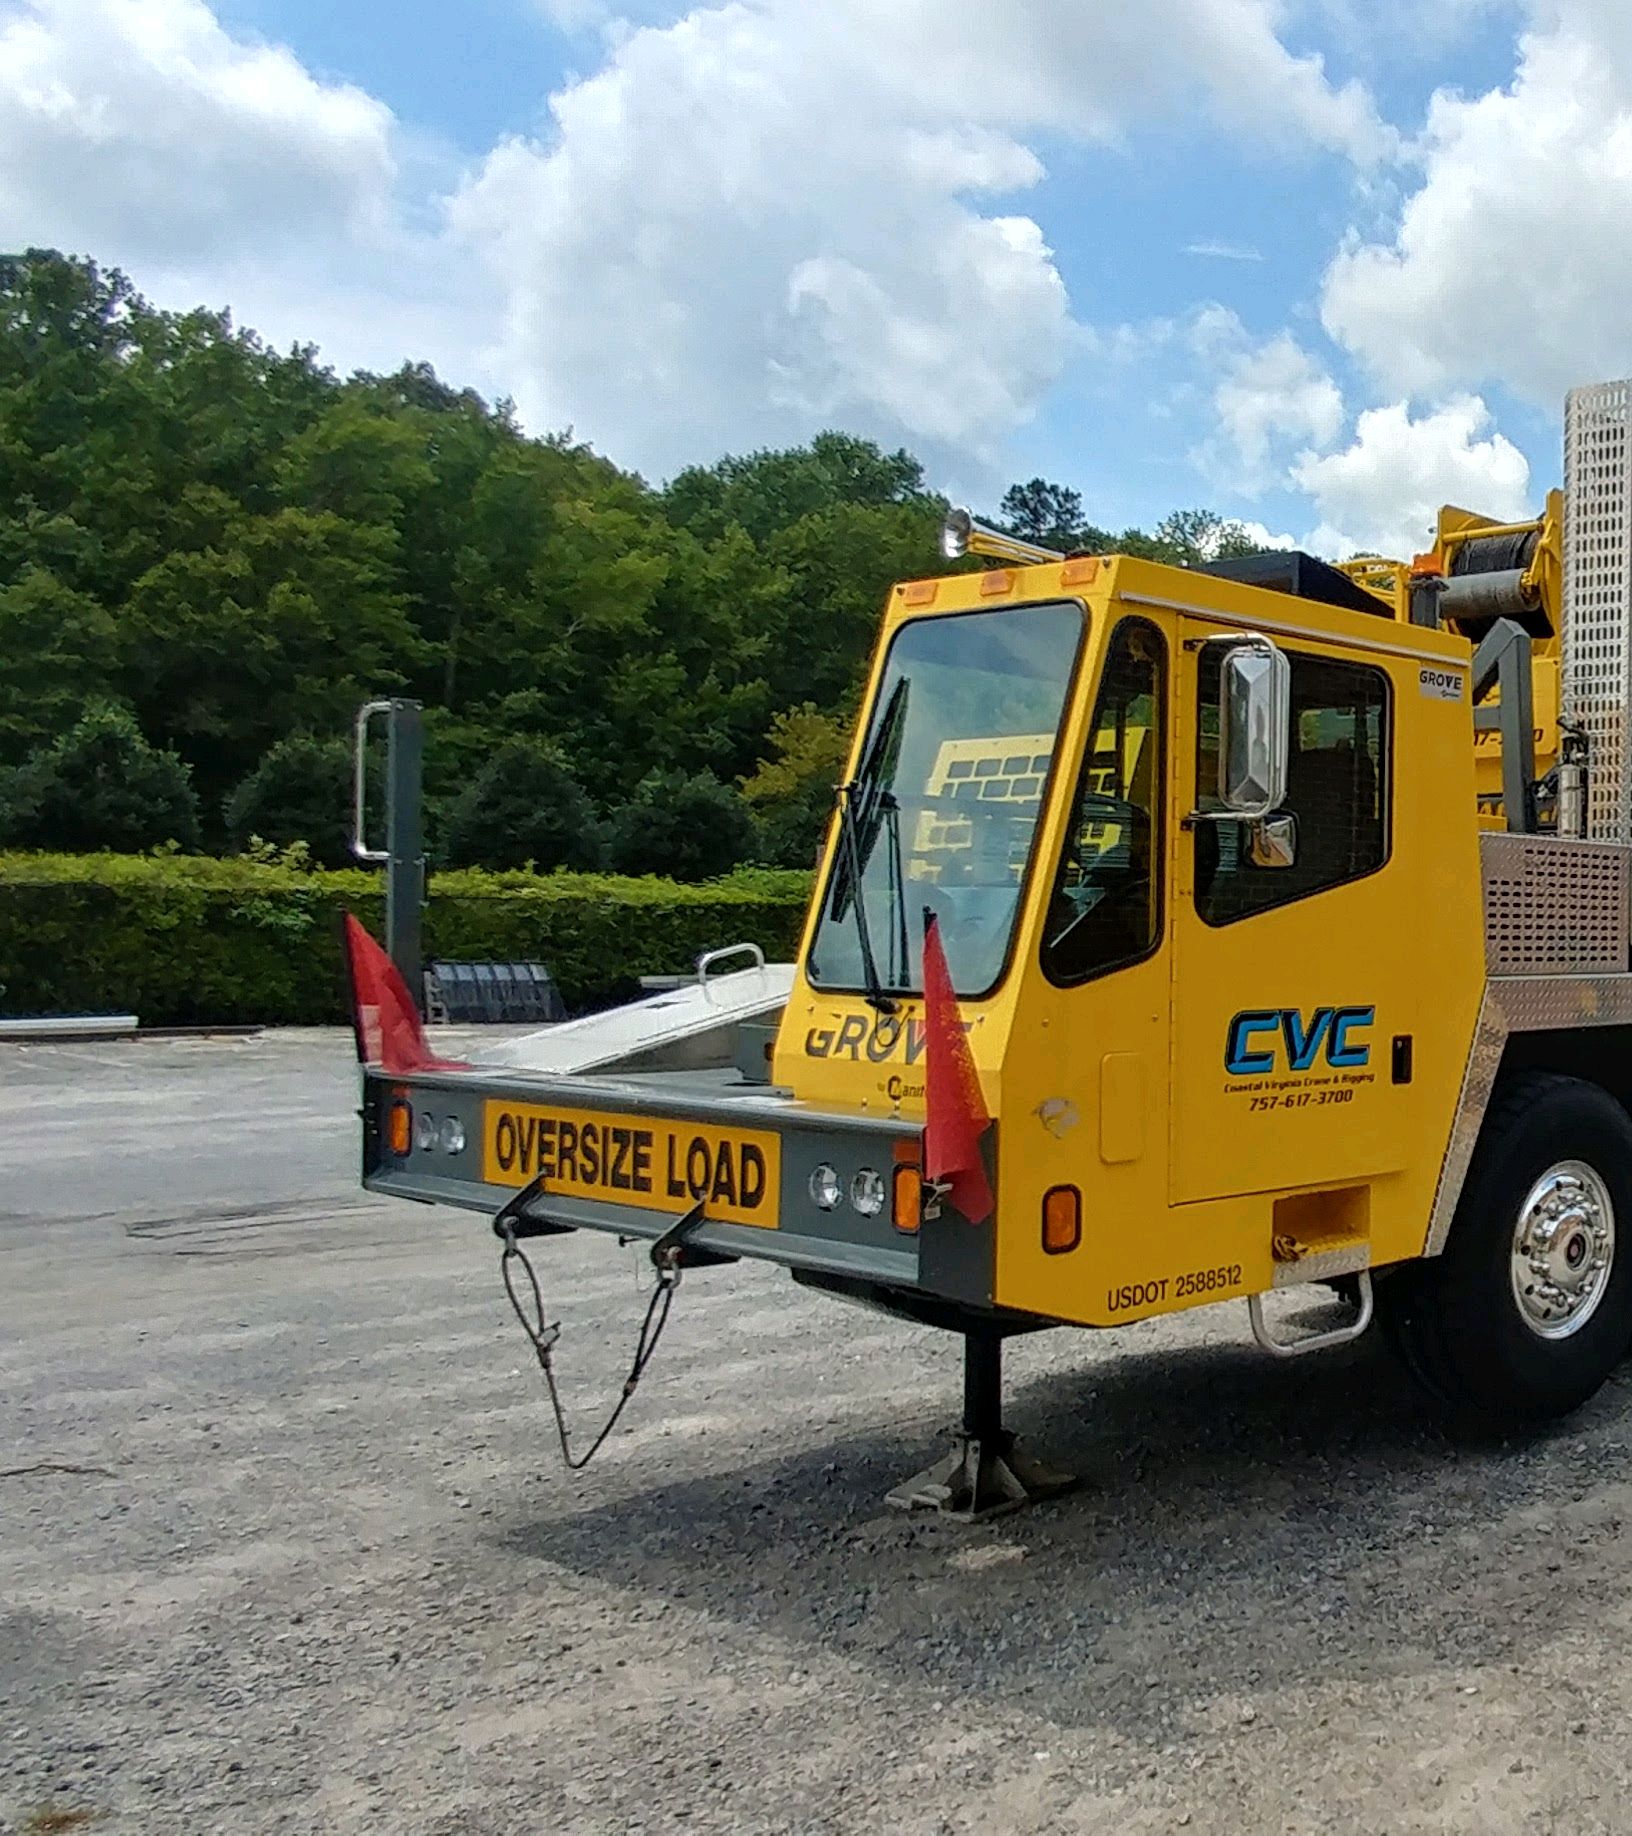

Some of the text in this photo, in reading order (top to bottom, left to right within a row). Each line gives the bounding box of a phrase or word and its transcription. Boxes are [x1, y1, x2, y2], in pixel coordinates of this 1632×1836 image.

[1420, 670, 1462, 690] GROVE
[1224, 1004, 1376, 1075] CVC
[1249, 1088, 1354, 1112] 757-617-3700
[1265, 1079, 1302, 1091] Virginia
[1304, 1076, 1331, 1087] Crane
[1333, 1075, 1339, 1084] &
[1341, 1073, 1375, 1085] Rigging
[496, 1112, 767, 1210] OVERSIZE LOAD
[1107, 1264, 1242, 1312] USDOT 2588512
